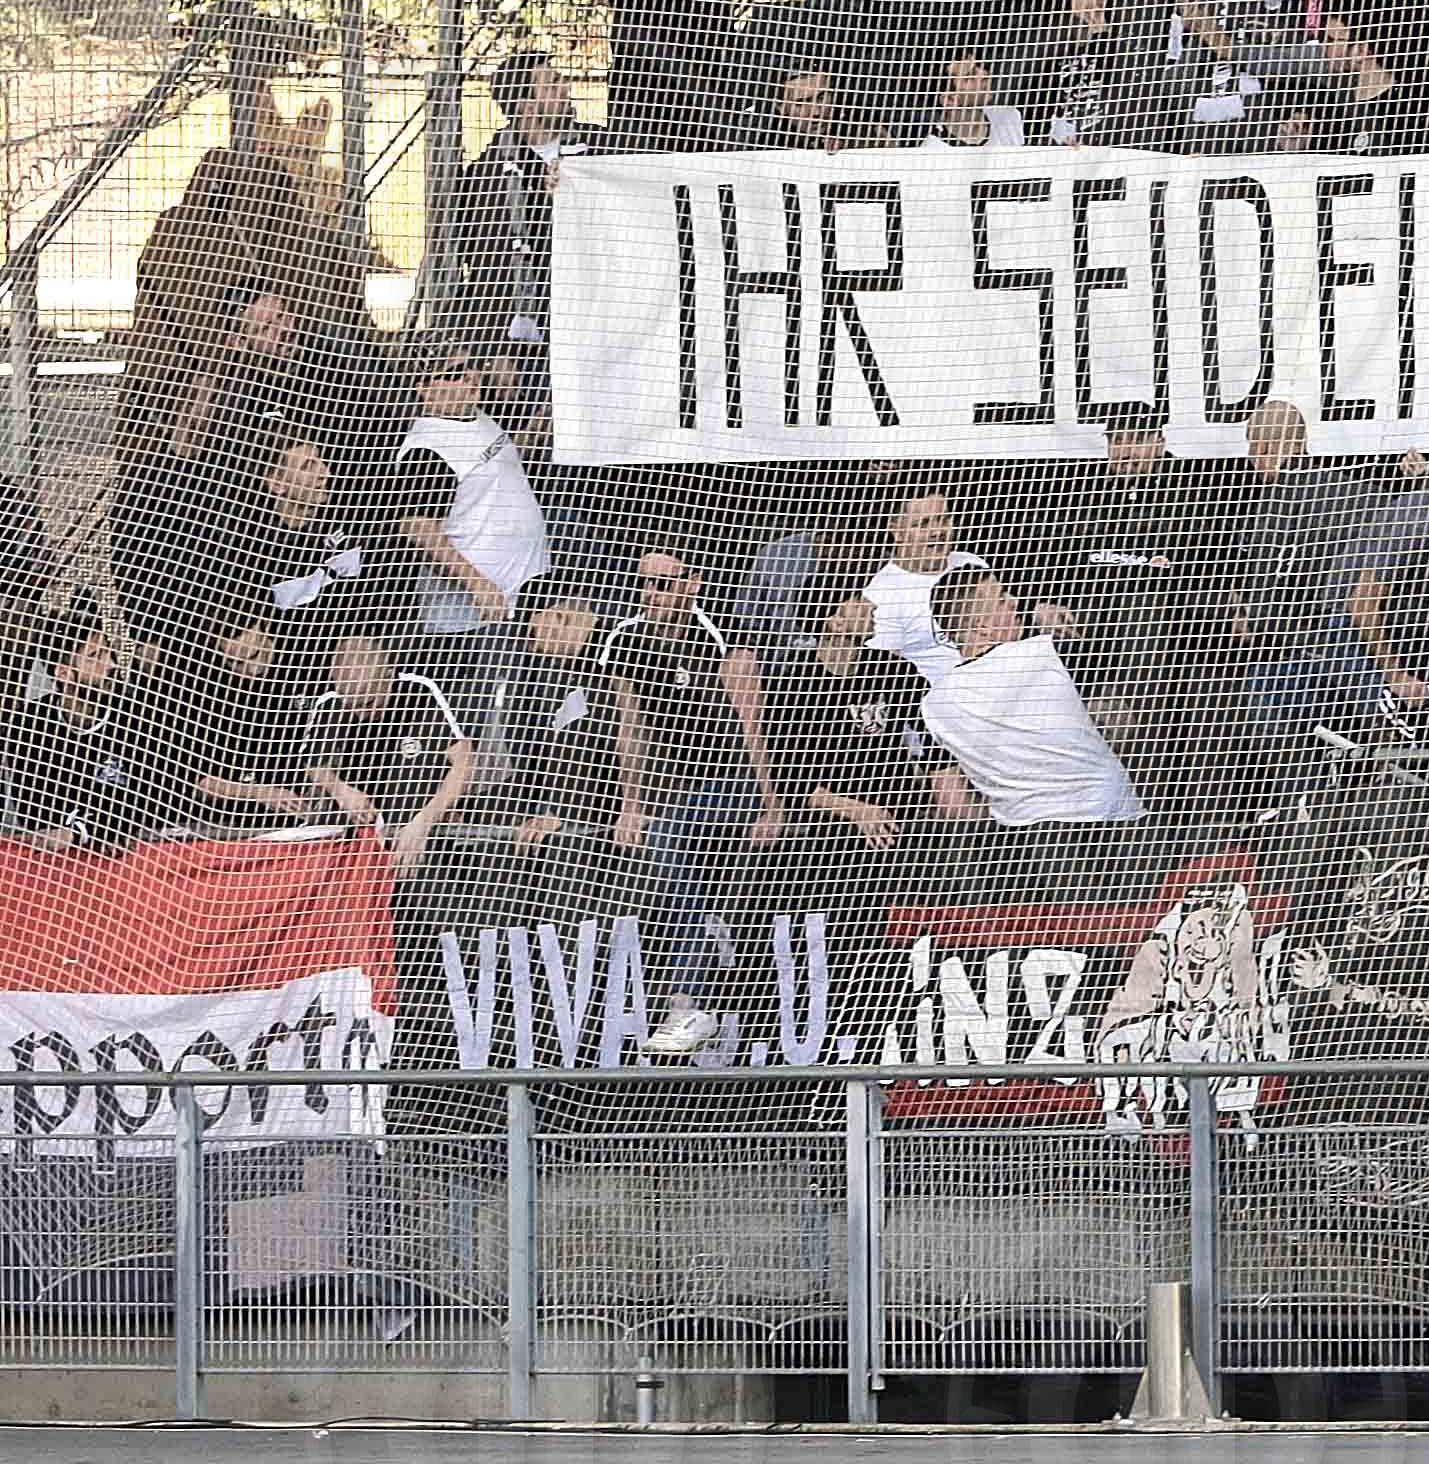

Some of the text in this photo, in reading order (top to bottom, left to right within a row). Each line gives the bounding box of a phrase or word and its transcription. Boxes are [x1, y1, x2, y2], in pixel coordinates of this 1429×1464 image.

[674, 181, 903, 428] IHR
[971, 175, 1273, 424] SEID
[1089, 550, 1149, 565] ellesse
[439, 916, 651, 1069] VIVA
